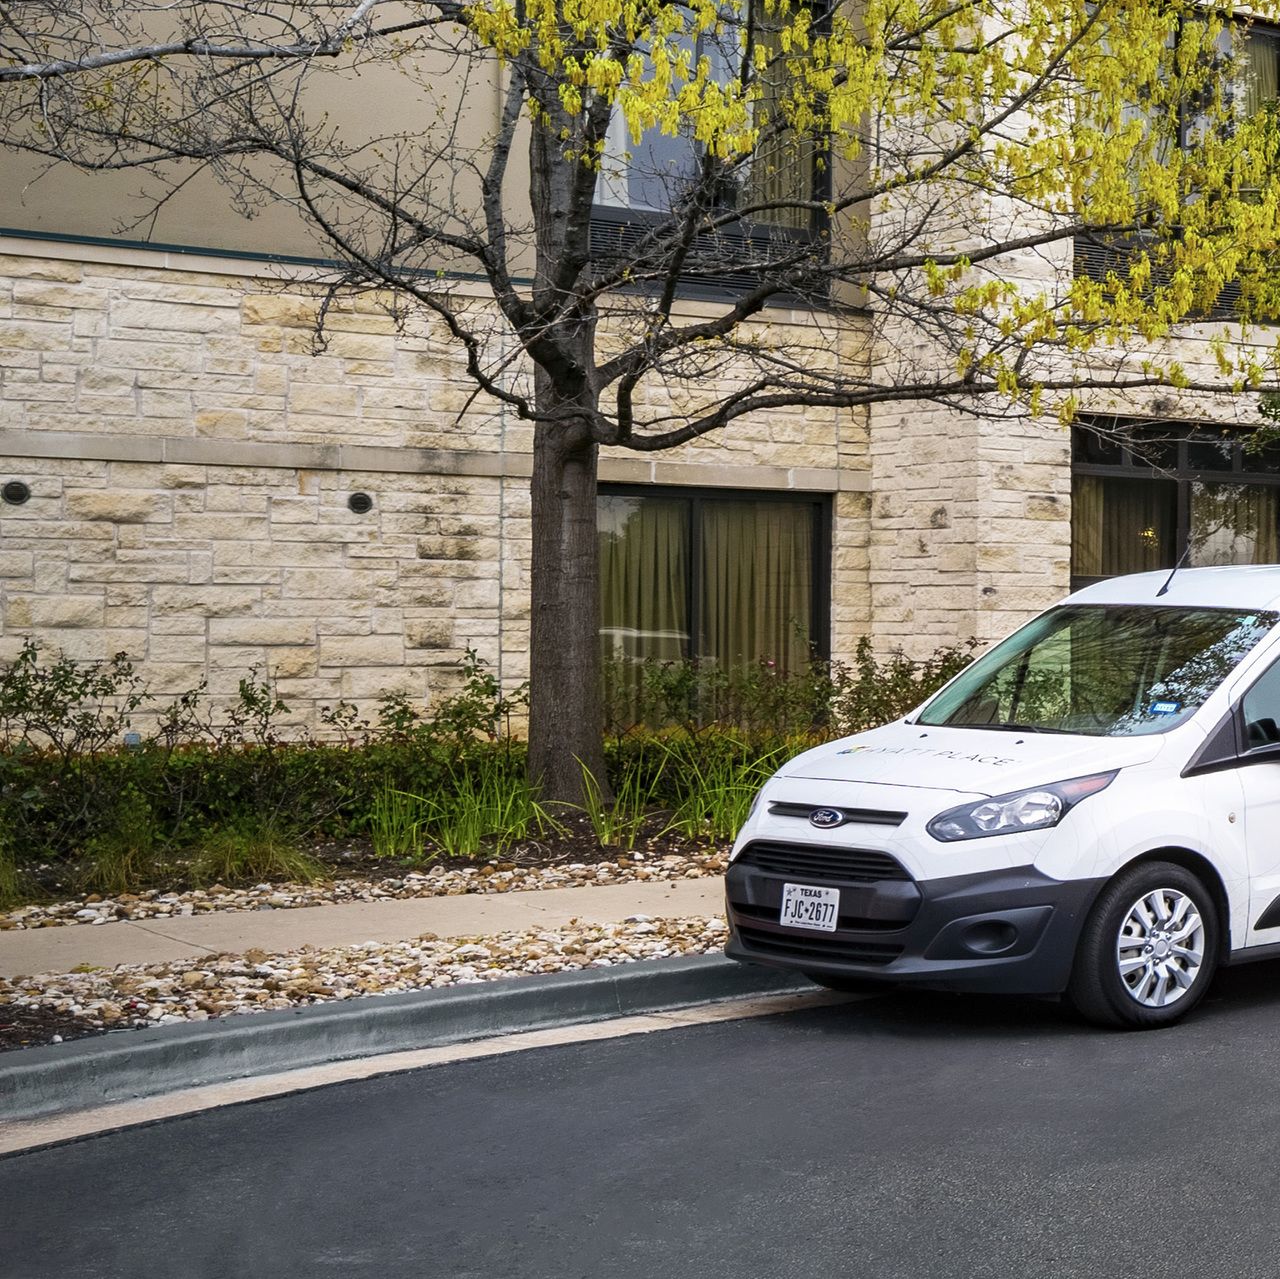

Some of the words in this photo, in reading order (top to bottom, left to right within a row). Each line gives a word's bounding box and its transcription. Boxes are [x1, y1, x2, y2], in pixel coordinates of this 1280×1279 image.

[934, 750, 1014, 766] PLACE
[813, 810, 834, 822] Ford
[800, 888, 822, 898] TEXAS
